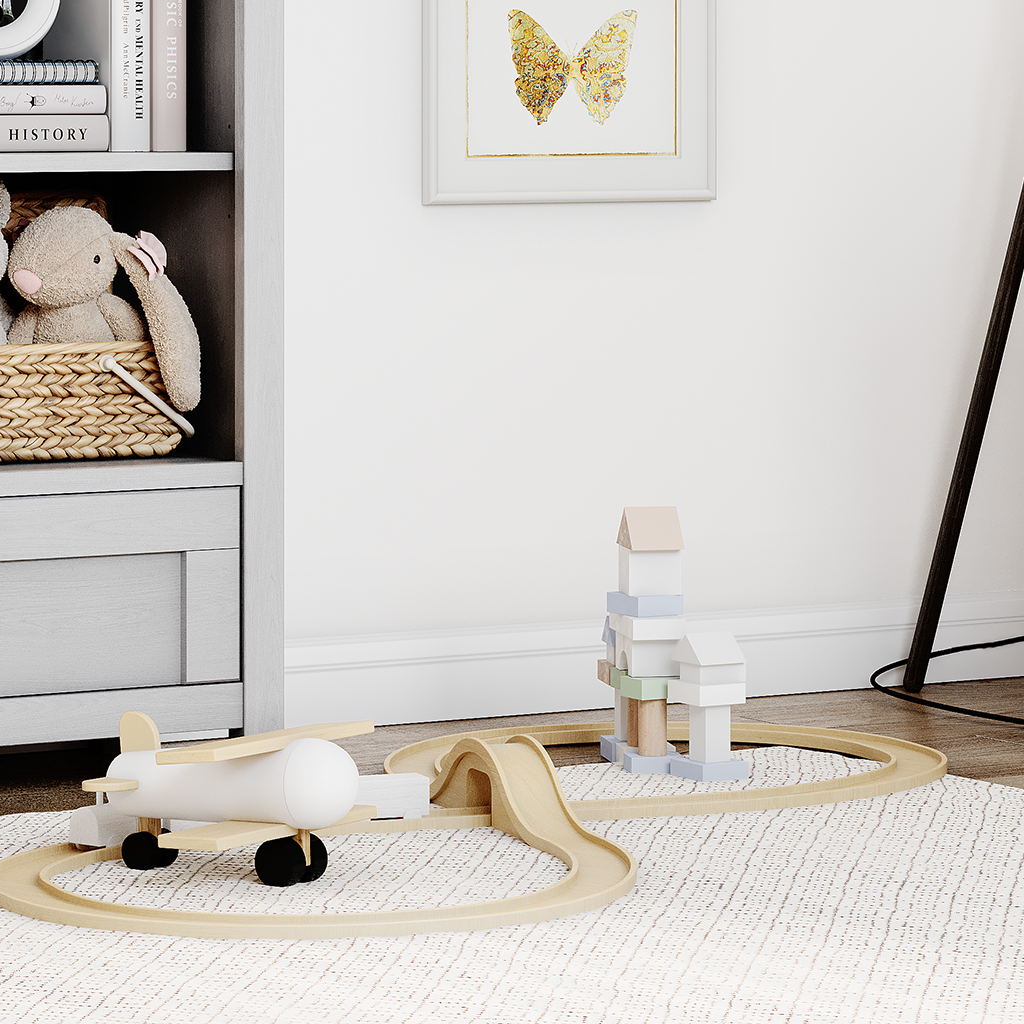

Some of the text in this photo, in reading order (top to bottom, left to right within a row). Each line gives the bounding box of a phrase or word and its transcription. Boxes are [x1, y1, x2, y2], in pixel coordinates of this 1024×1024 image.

[121, 5, 130, 34] Pilgrim
[135, 35, 144, 77] MENTAL
[166, 36, 177, 99] PHISICS
[135, 79, 144, 119] HEALTH
[8, 127, 88, 141] HISTORY
